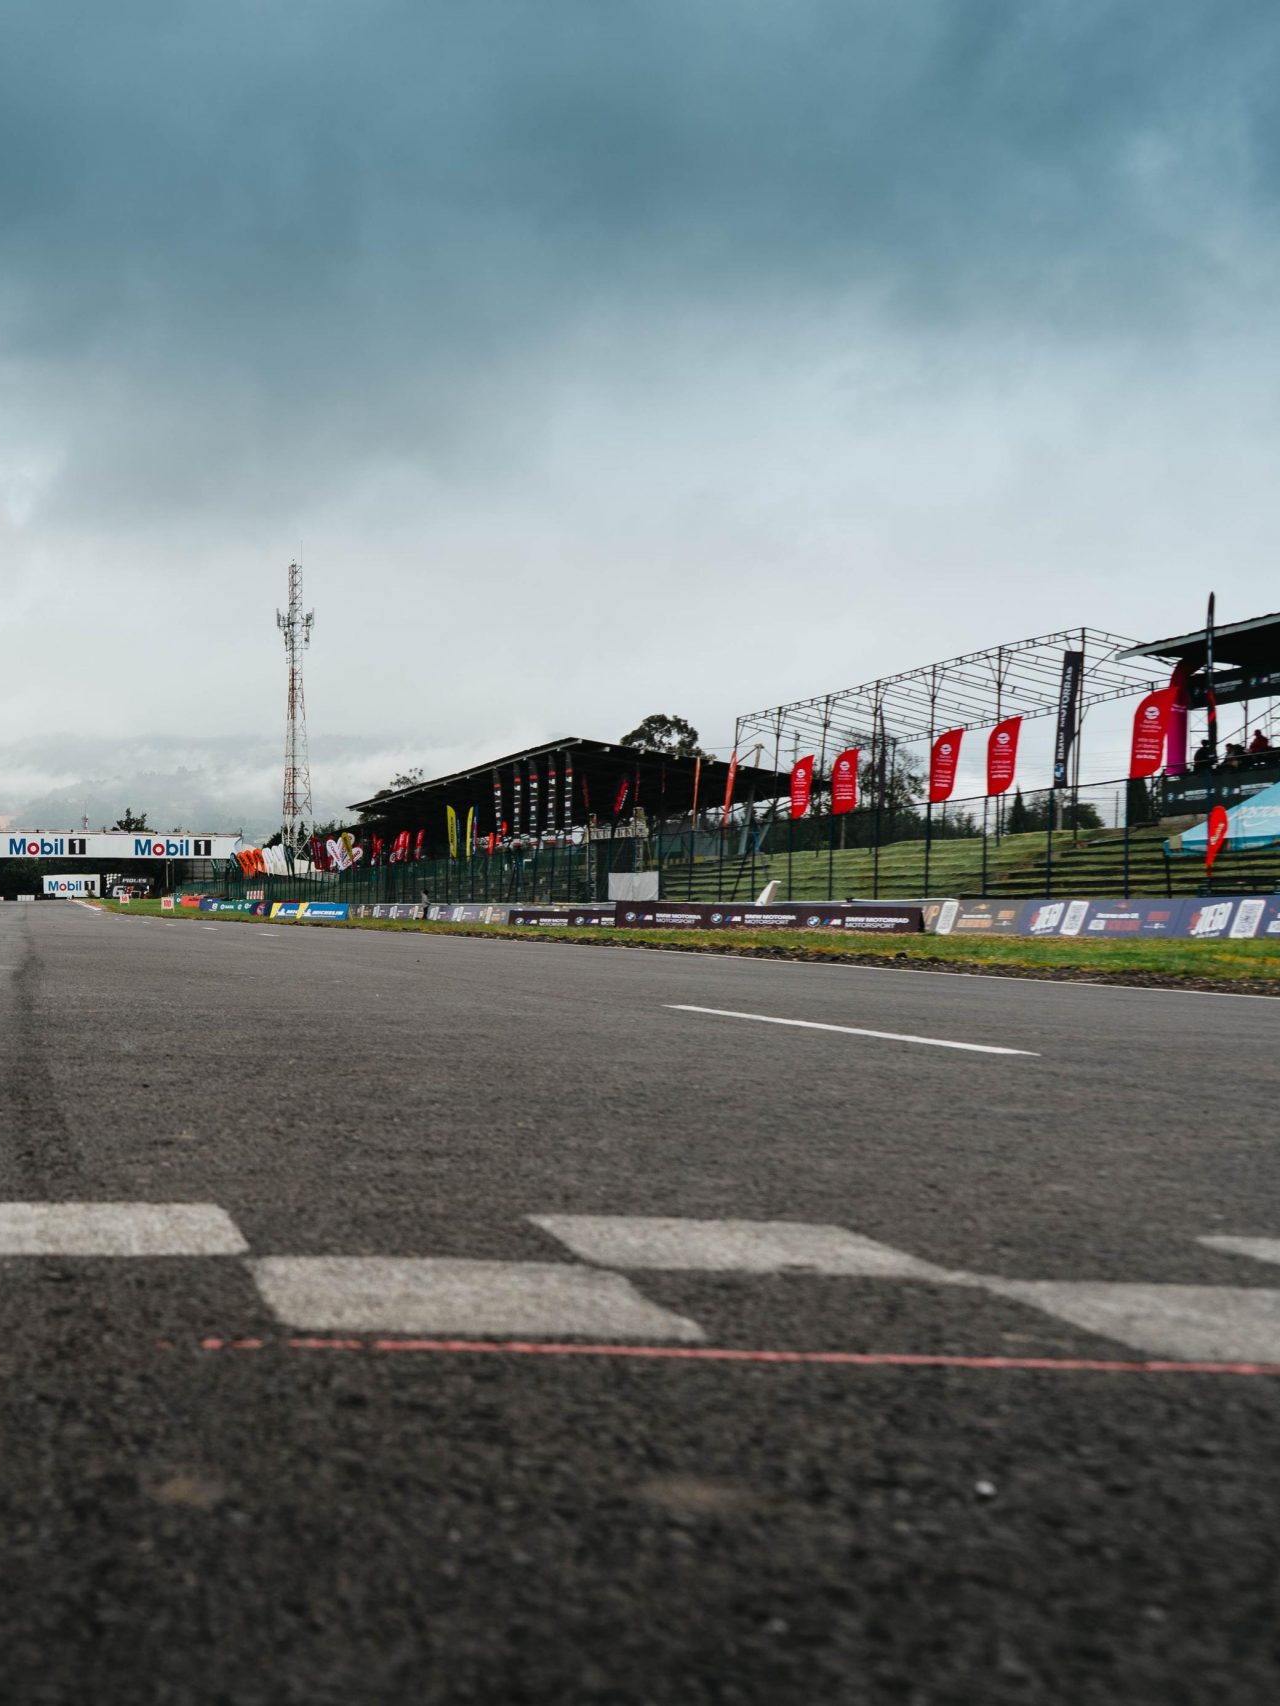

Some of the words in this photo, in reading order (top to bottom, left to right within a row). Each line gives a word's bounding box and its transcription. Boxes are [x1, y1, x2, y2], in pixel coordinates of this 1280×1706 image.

[9, 838, 64, 856] Mobil
[134, 839, 189, 856] Mobil
[48, 881, 81, 891] Mobil
